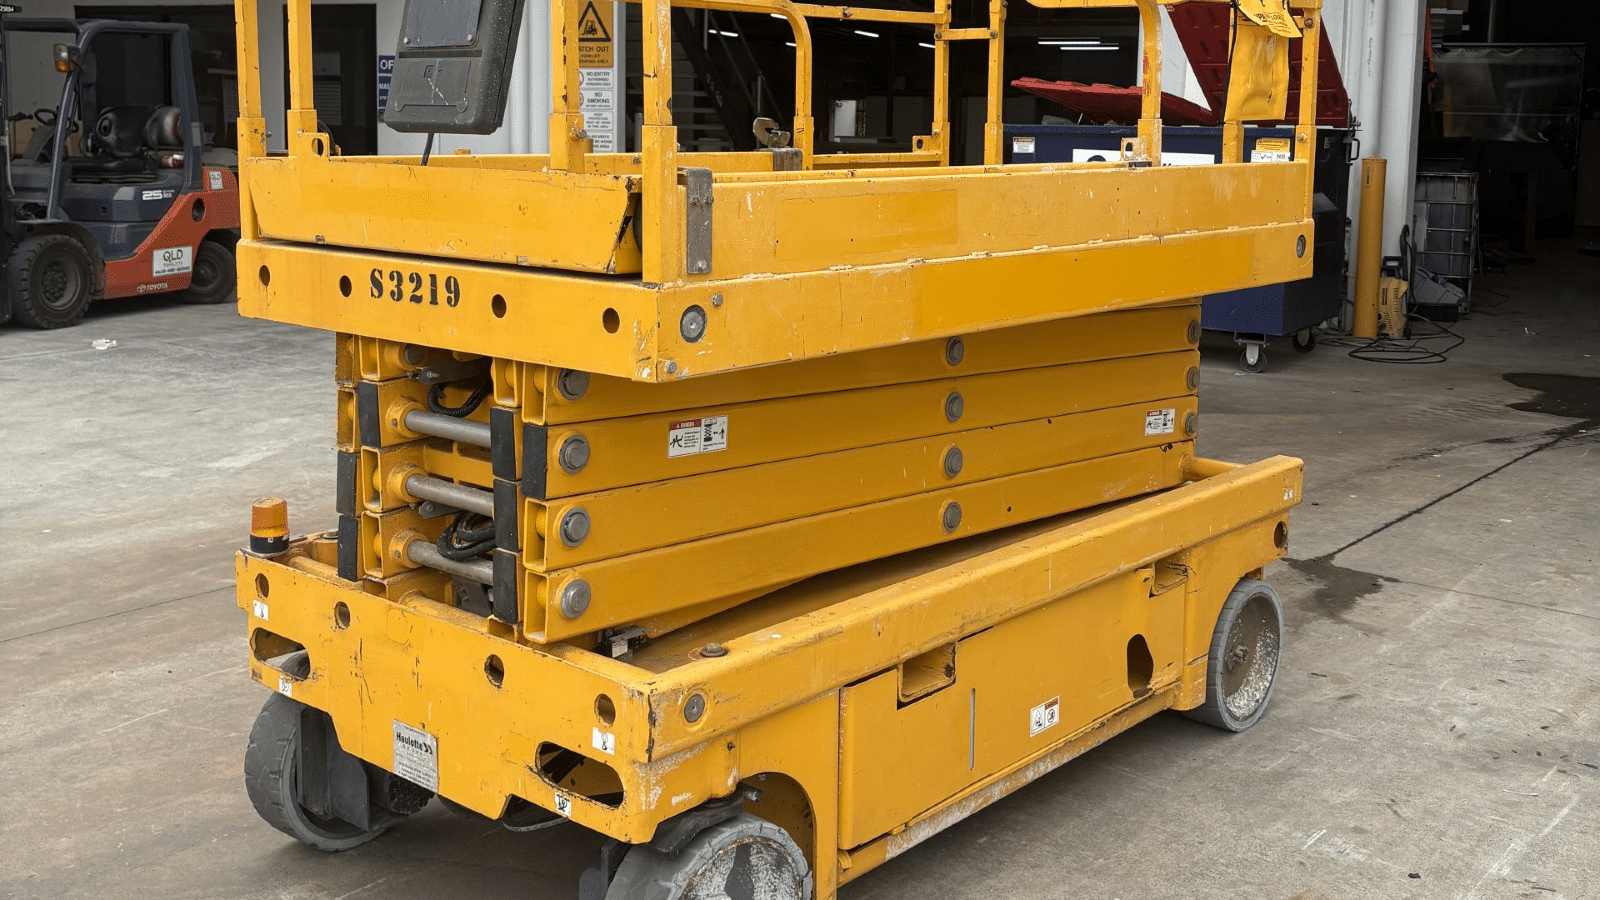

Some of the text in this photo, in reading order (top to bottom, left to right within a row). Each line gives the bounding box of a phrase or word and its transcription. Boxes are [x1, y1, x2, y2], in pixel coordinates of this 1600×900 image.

[142, 190, 163, 200] 25
[163, 249, 183, 263] QLD
[370, 267, 461, 308] S3219
[396, 731, 423, 751] Haulotte
